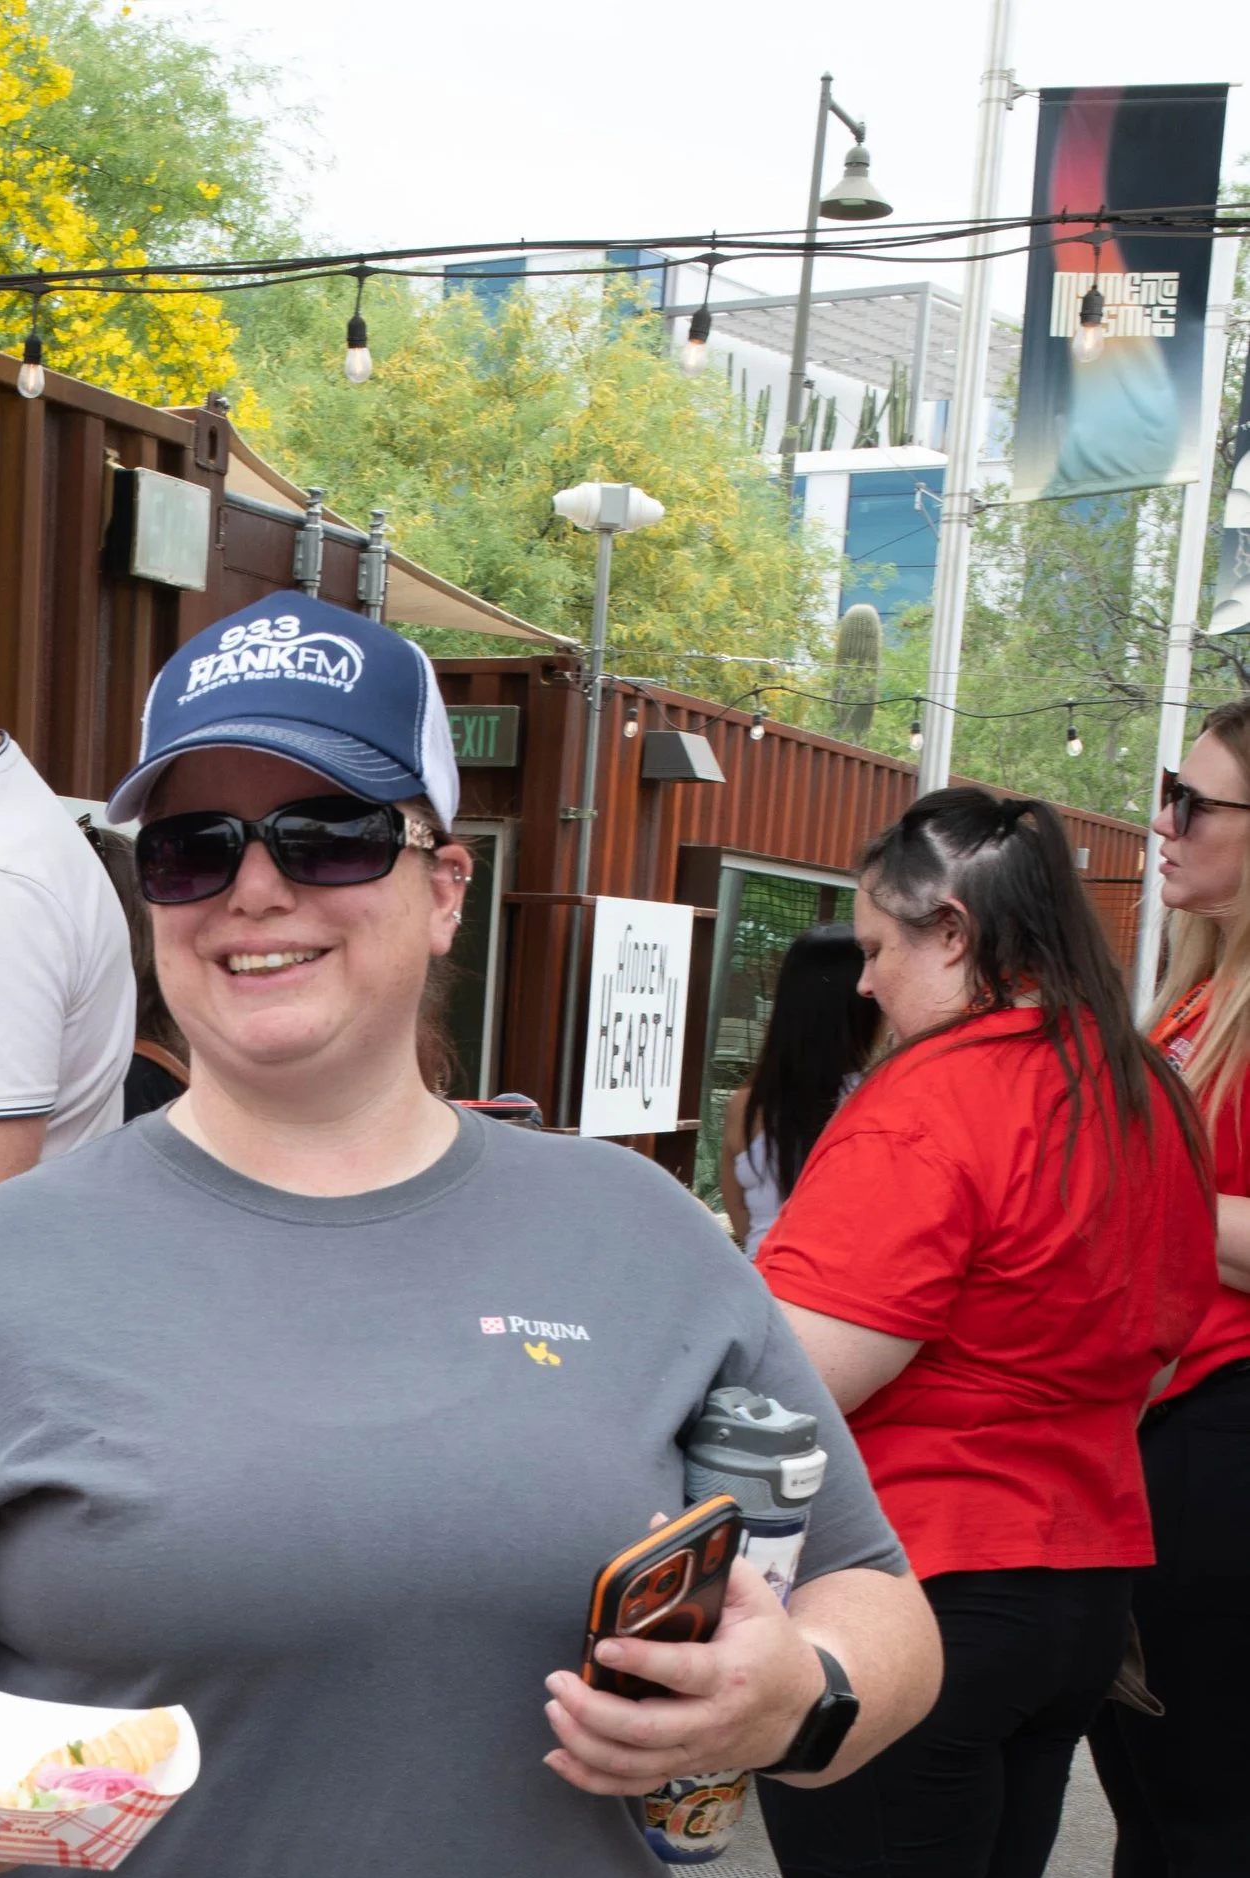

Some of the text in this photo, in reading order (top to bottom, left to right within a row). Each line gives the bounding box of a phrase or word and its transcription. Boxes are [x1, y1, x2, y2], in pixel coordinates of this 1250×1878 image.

[243, 669, 281, 681] Real
[283, 669, 354, 693] Country
[448, 715, 501, 758] EXIT
[594, 973, 679, 1109] HEARTH
